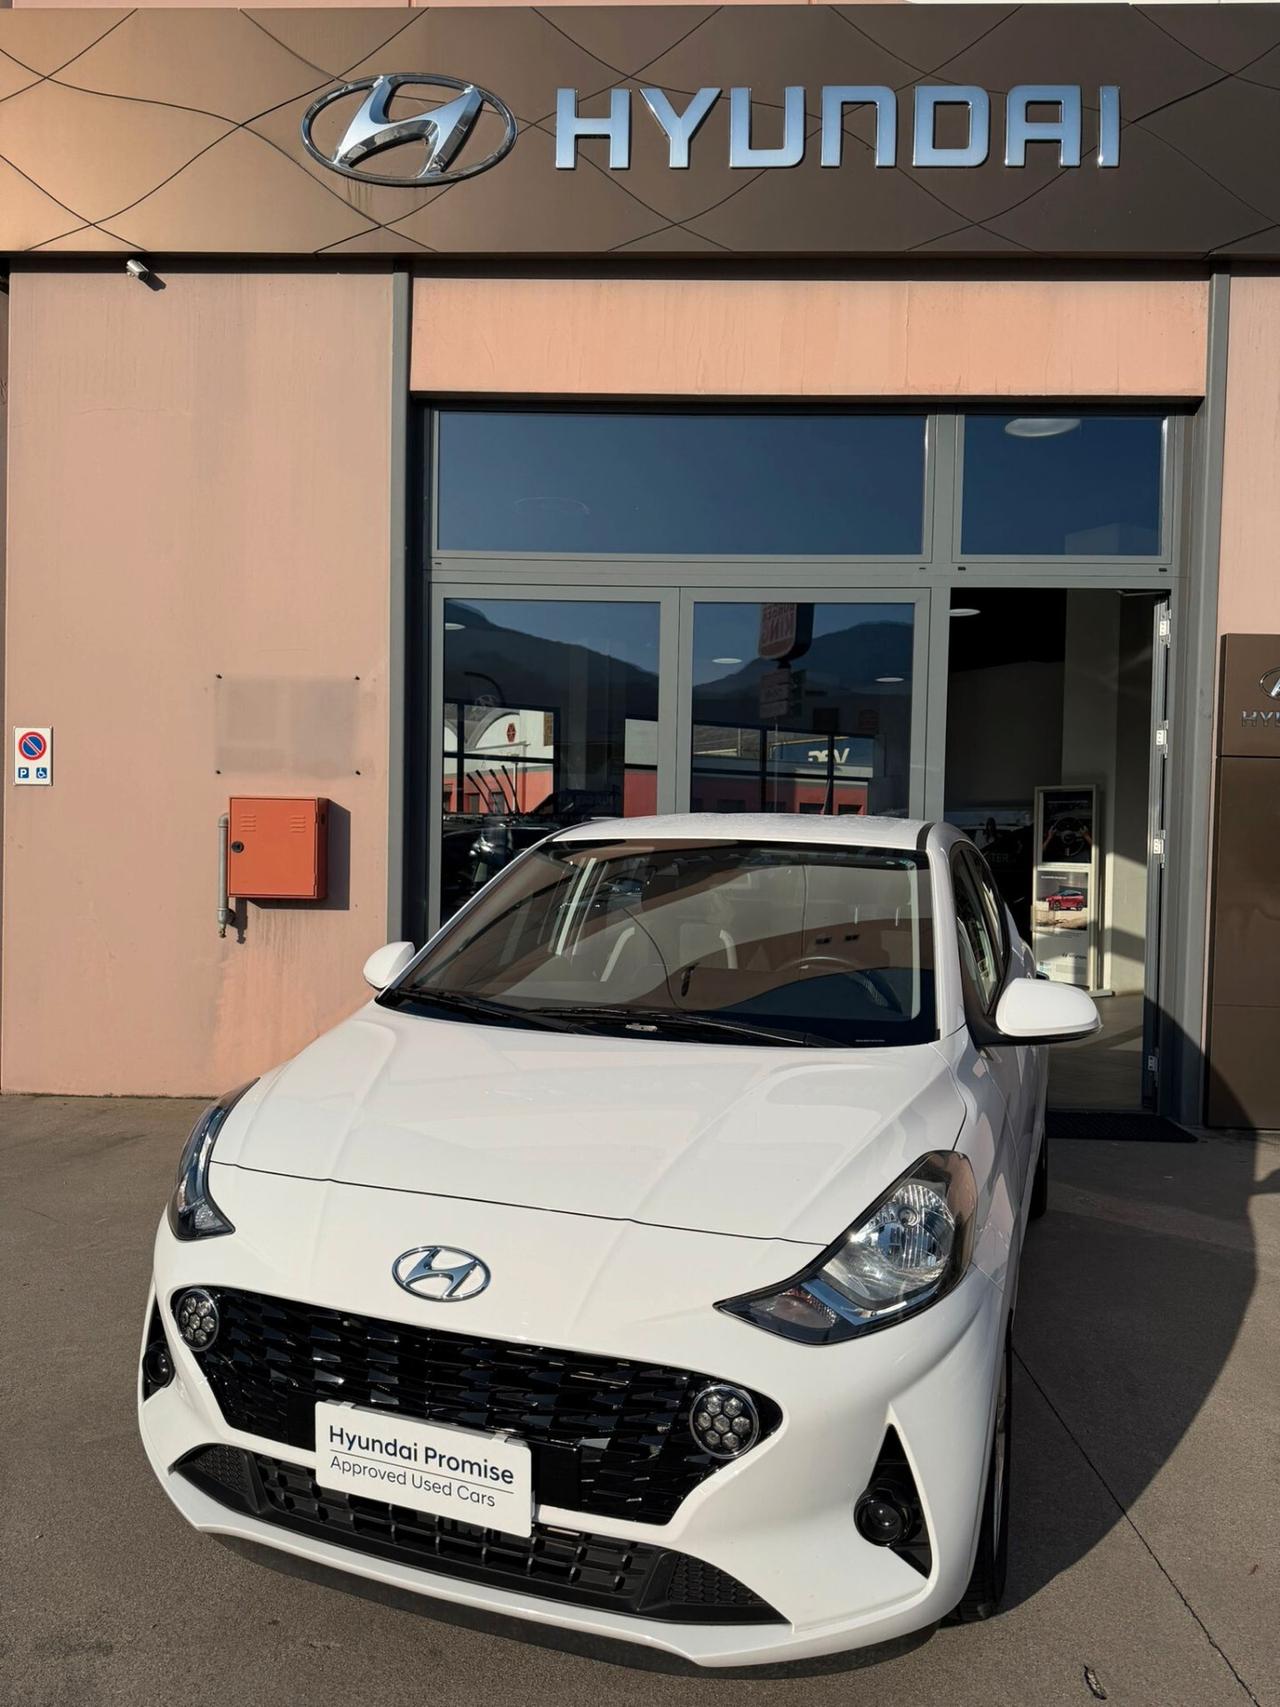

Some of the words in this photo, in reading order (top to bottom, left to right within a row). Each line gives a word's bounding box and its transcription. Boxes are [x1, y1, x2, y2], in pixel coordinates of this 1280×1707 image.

[555, 84, 1120, 169] HYUNDAI
[329, 1425, 418, 1462] Hyundai
[424, 1447, 514, 1485] Promise
[330, 1456, 407, 1486] Approved
[411, 1474, 452, 1497] Used
[457, 1486, 496, 1508] Cars
